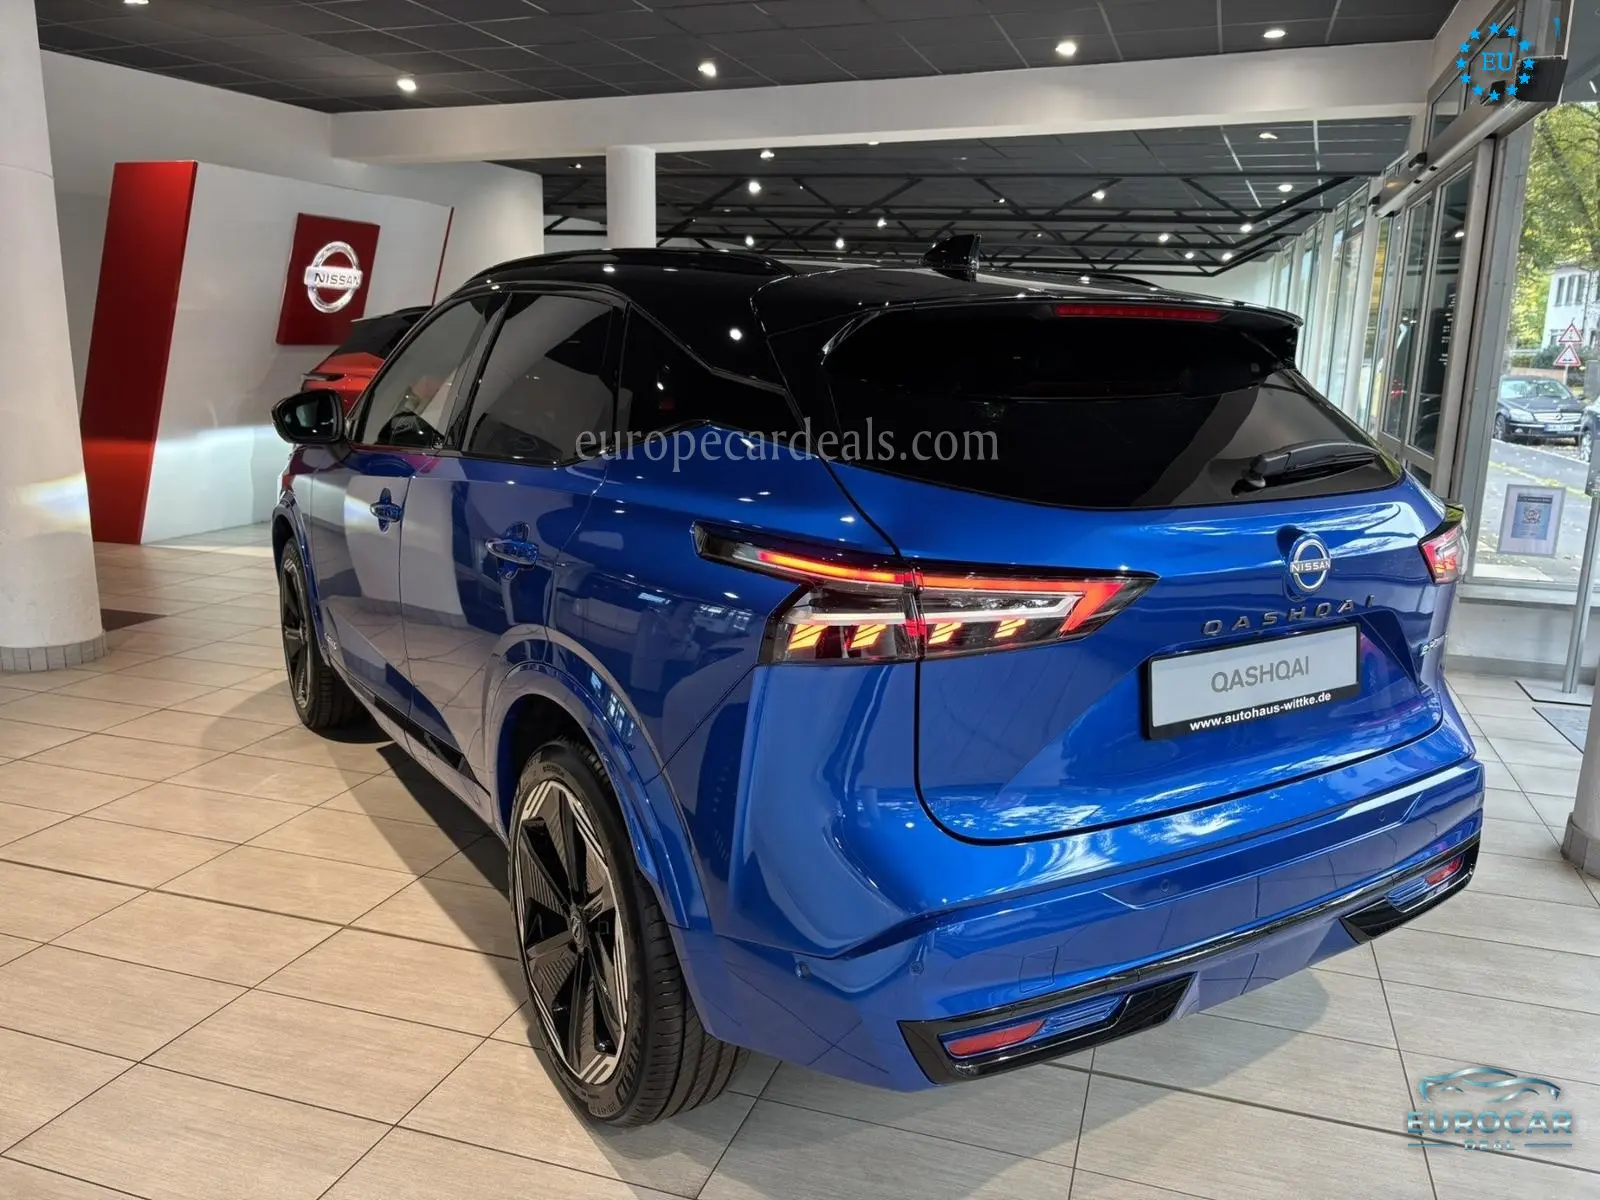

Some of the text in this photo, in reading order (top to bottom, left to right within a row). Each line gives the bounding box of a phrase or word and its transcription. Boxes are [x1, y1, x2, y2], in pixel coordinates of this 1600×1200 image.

[1291, 560, 1330, 572] NISSAN
[1203, 594, 1376, 637] QASHQAI
[1211, 656, 1310, 694] QASHQAI
[1190, 692, 1332, 731] www.autohaus-wittke.de
